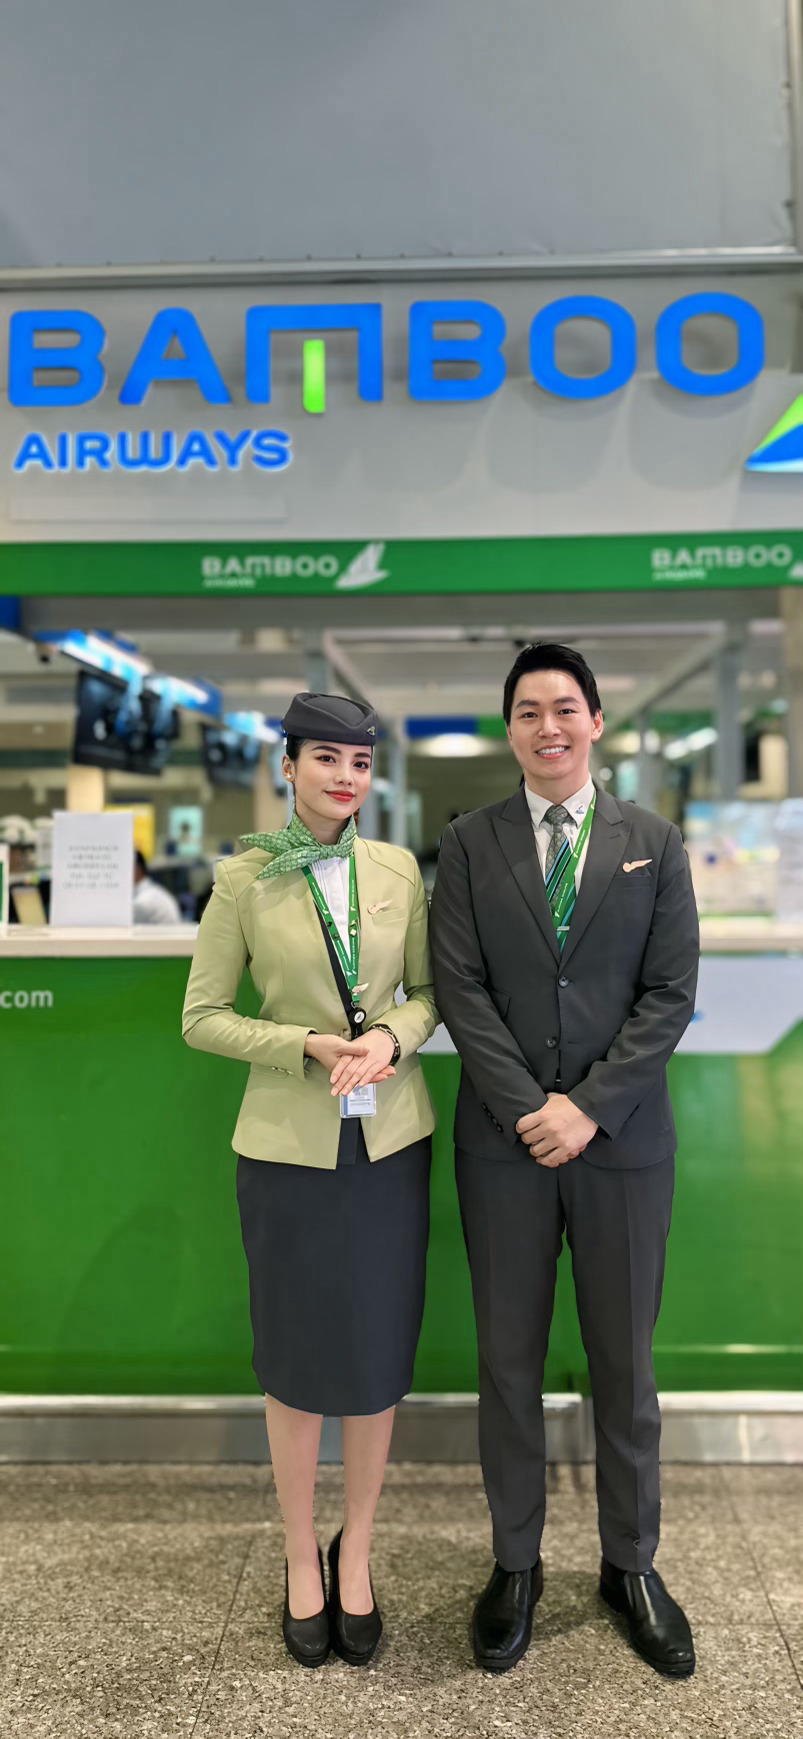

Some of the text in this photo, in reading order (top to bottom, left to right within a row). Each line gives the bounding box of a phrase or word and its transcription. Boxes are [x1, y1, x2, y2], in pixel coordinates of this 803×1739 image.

[8, 292, 766, 413] BAMBOO
[14, 429, 292, 470] AIRWAYS
[202, 555, 339, 578] BAMBOO
[652, 544, 793, 570] BAMBOO
